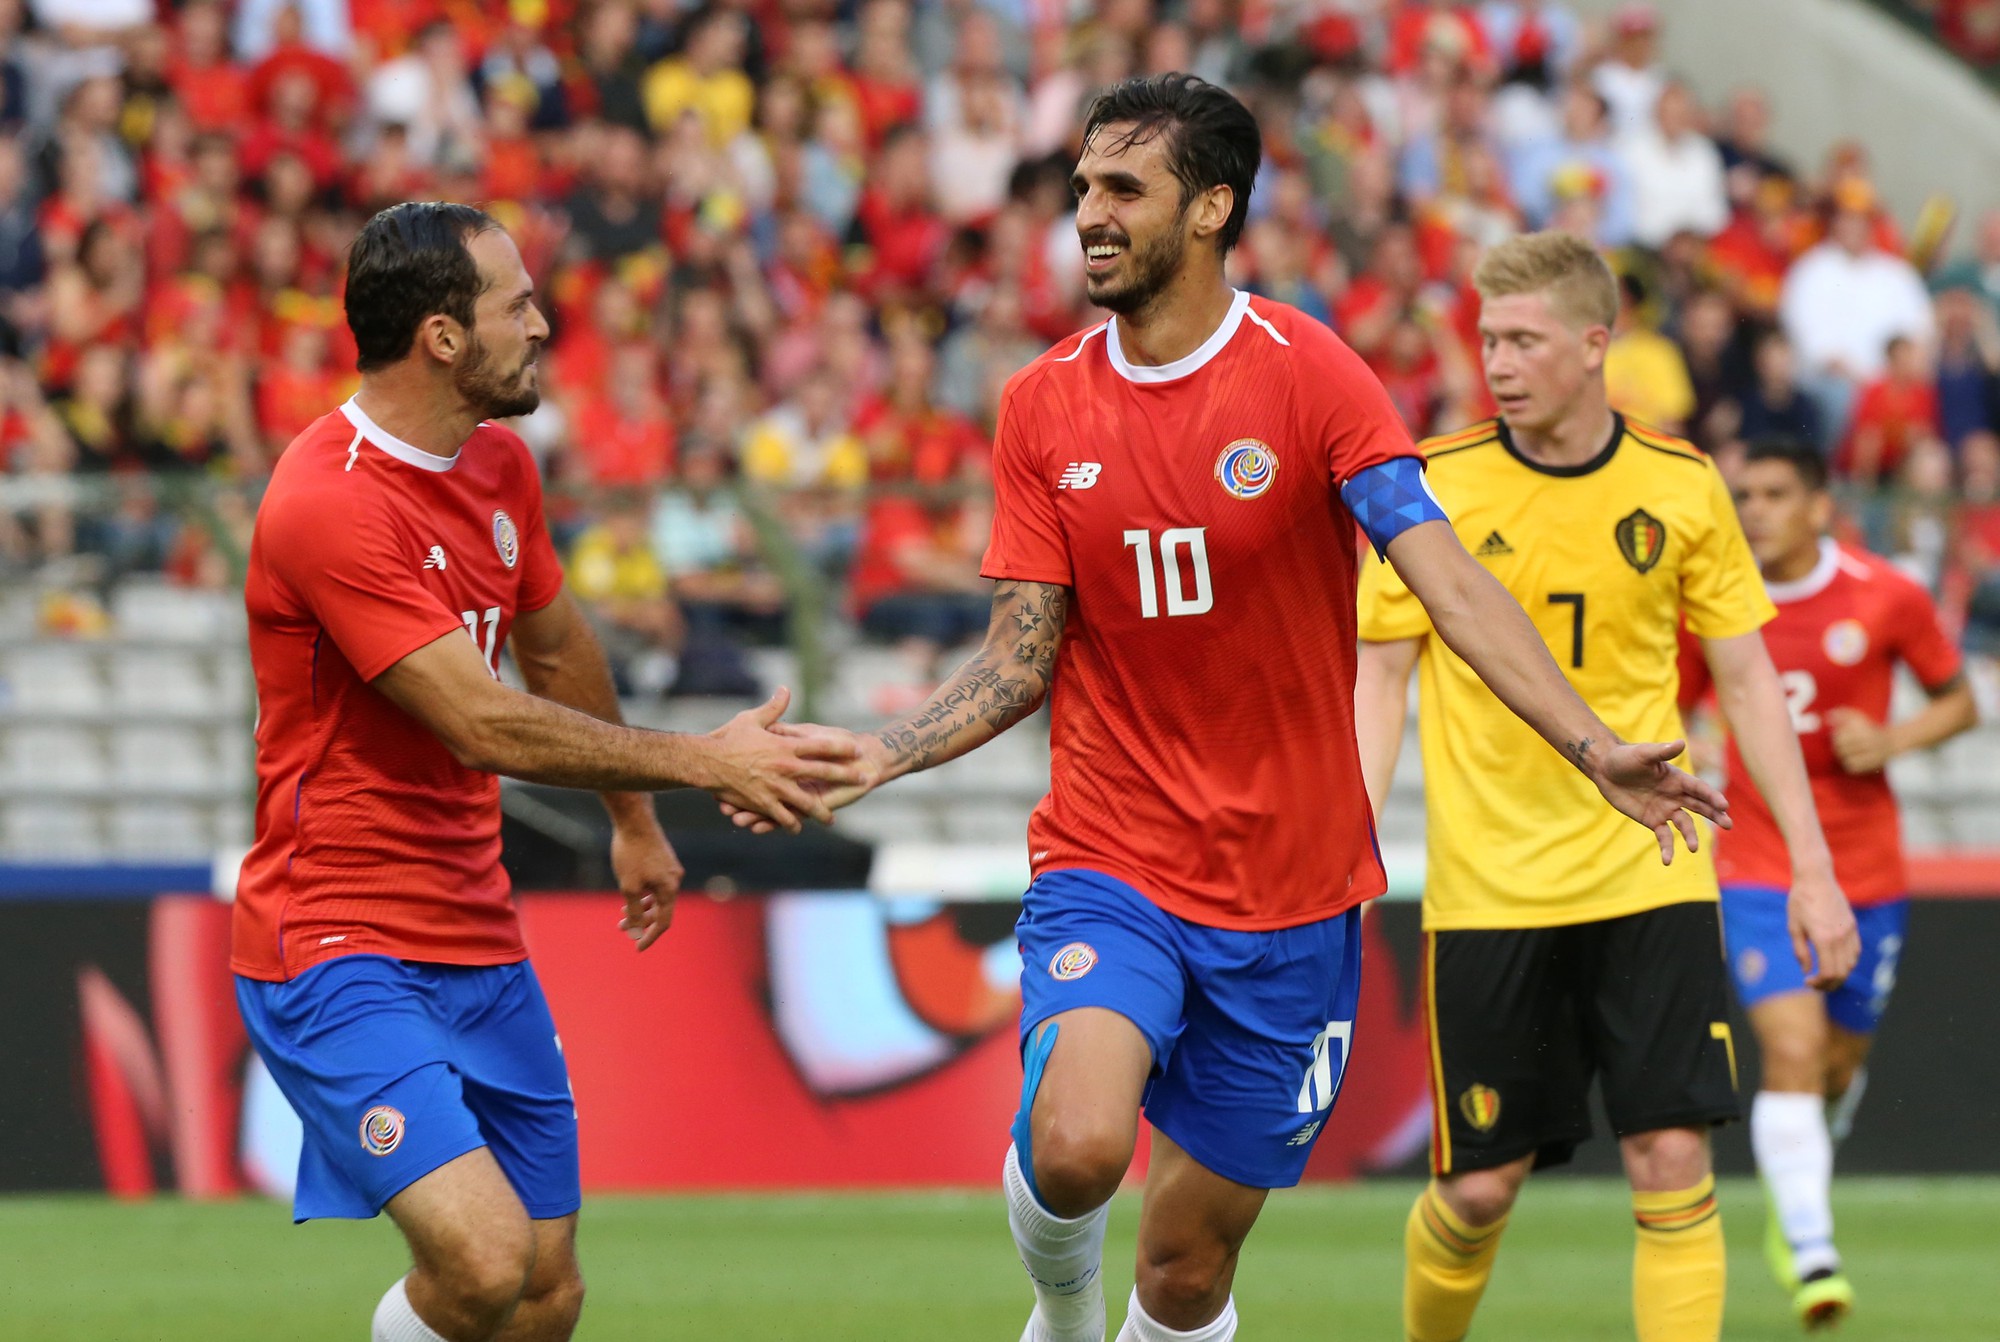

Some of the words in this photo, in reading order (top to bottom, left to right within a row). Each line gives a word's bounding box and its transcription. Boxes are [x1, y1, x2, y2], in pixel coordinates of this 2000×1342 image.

[1123, 526, 1214, 619] 10
[1546, 592, 1584, 669] 7
[965, 711, 977, 726] de
[1297, 1020, 1352, 1113] 10
[1709, 1021, 1739, 1094] 7
